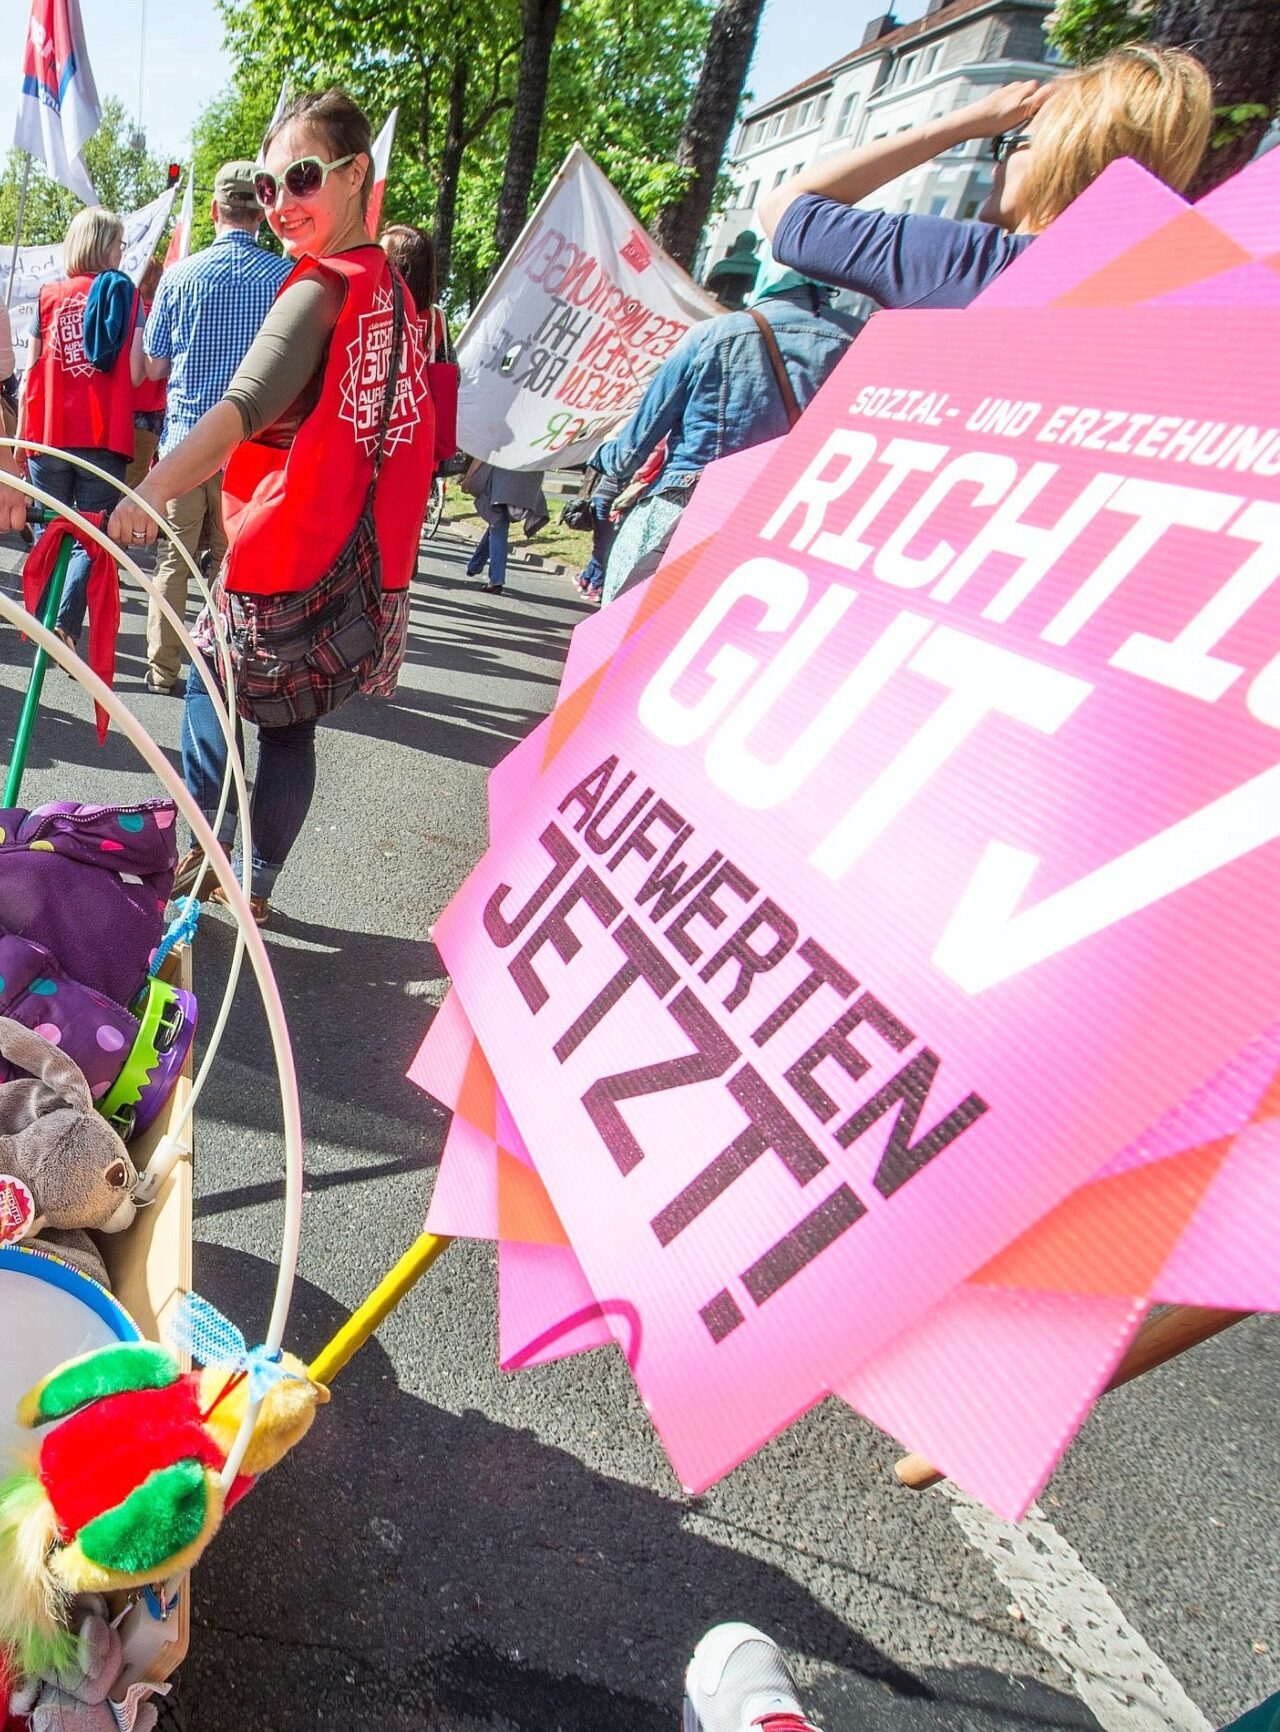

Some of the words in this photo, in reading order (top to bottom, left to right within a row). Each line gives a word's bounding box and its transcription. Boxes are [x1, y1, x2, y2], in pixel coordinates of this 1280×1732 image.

[61, 322, 83, 342] GU
[849, 385, 961, 426] SOZIAL-
[965, 397, 1042, 437] UND
[637, 556, 1096, 882] GUT
[760, 427, 1280, 732] RICHTI
[483, 820, 870, 1346] JETZT!
[556, 753, 991, 1201] AUFWERTEN
